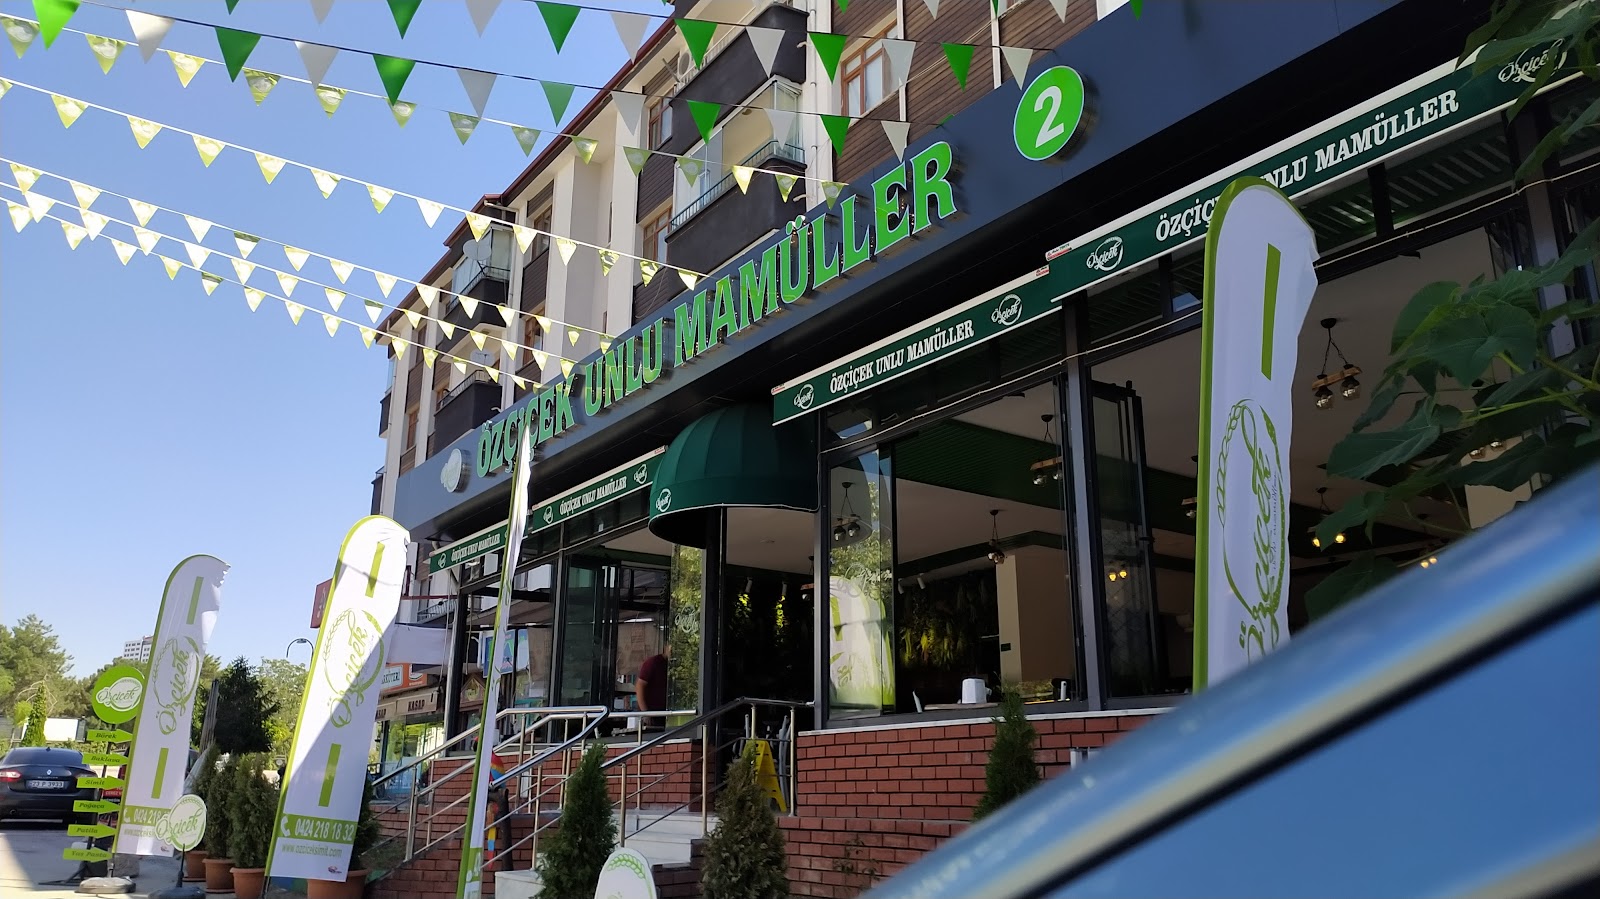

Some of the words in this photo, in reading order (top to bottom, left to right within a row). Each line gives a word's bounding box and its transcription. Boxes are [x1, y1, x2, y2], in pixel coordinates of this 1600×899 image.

[1033, 85, 1065, 148] 2
[1155, 196, 1221, 242] ÖZÇİÇ
[1260, 156, 1308, 189] NLU
[1314, 89, 1460, 173] MAMÜLLER
[476, 373, 575, 478] ÖZÇİÇEK
[584, 316, 664, 417] UNLU
[673, 140, 957, 368] MAMÜLLER
[829, 362, 874, 394] ÖZÇİÇEK
[875, 348, 904, 375] UNLU
[906, 319, 975, 363] MAMÜLLER
[295, 818, 314, 837] 0424
[313, 820, 330, 839] 218
[331, 822, 343, 840] 18
[342, 824, 355, 841] 32
